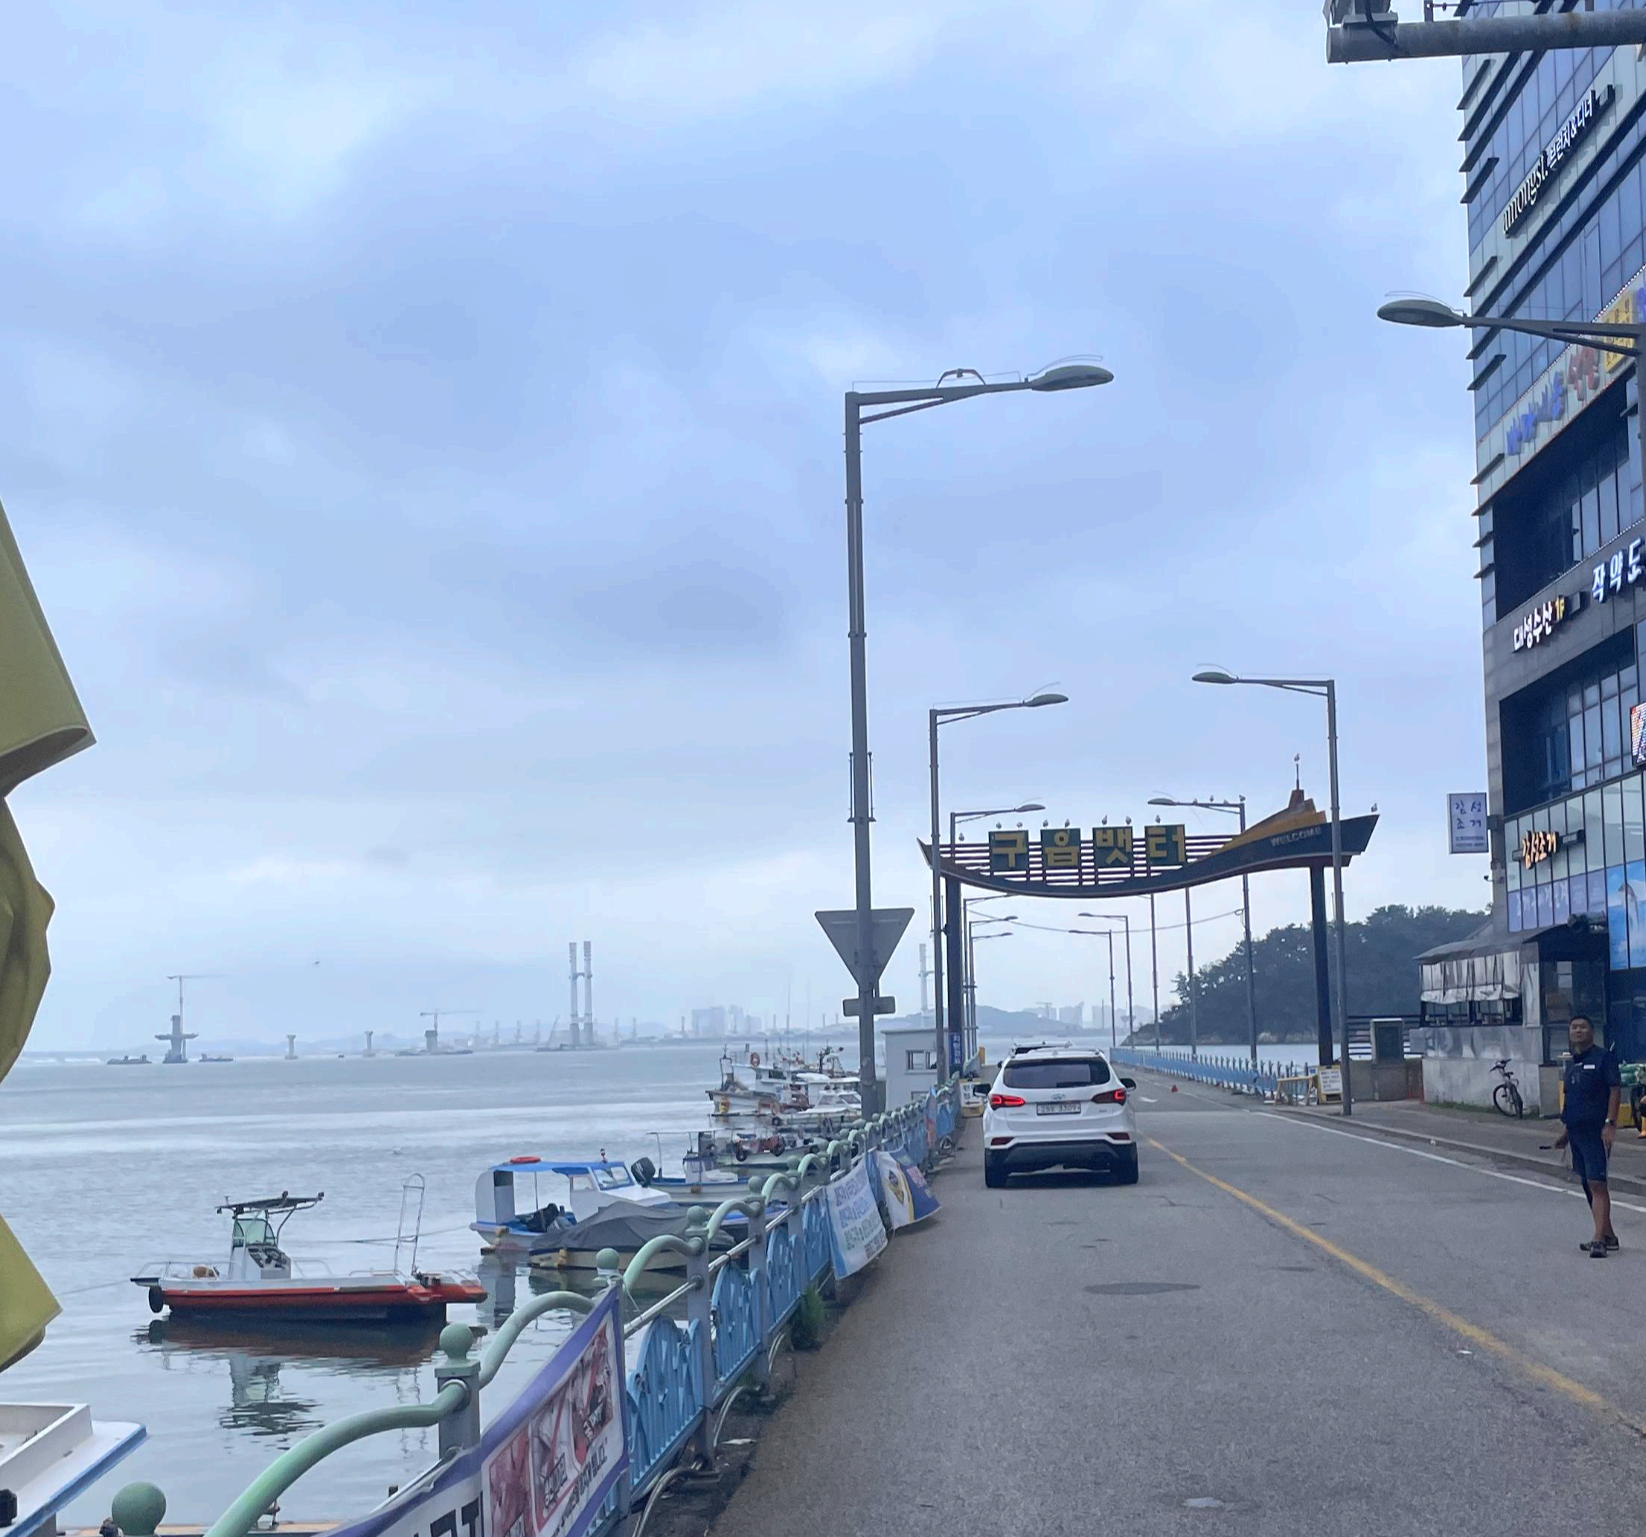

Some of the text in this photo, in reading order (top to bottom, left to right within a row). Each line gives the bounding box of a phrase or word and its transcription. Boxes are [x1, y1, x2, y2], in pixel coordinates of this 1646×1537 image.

[1549, 90, 1593, 169] 브런치&디너
[1592, 538, 1643, 603] 작약도
[992, 826, 1186, 868] 구읍뱃터
[1269, 826, 1322, 847] WELCOME
